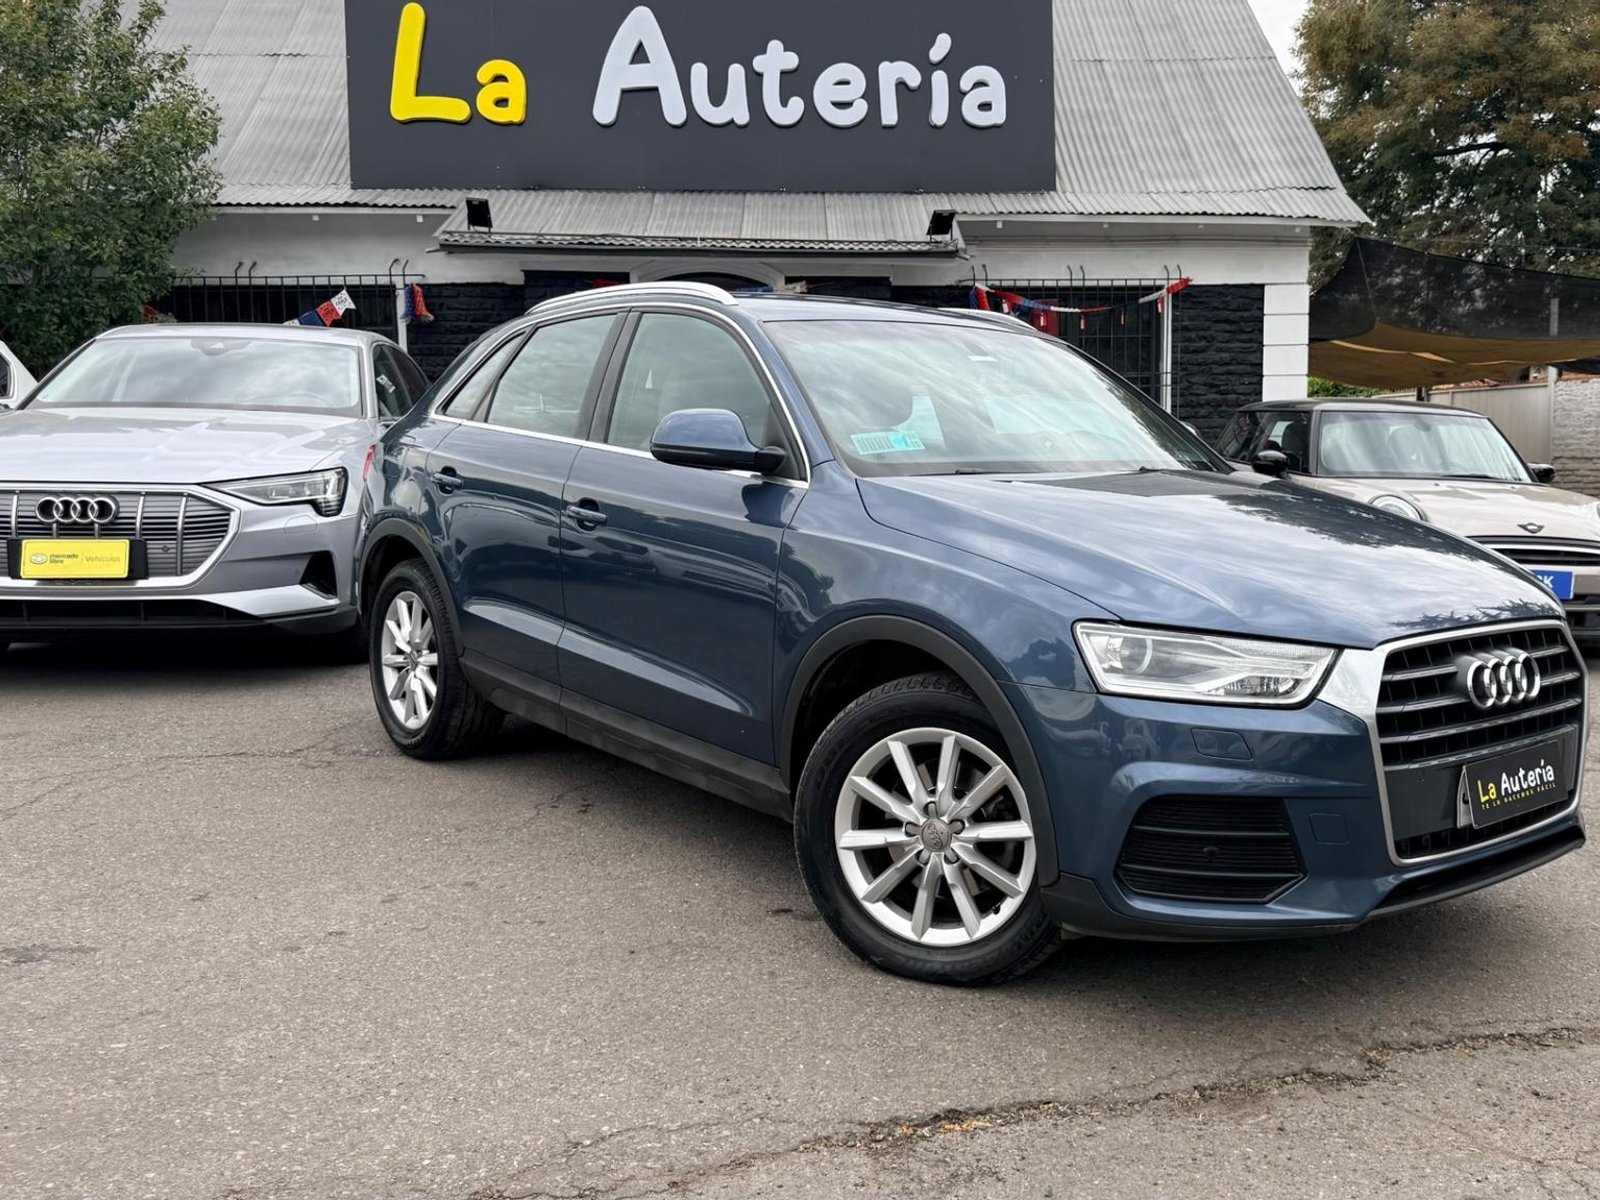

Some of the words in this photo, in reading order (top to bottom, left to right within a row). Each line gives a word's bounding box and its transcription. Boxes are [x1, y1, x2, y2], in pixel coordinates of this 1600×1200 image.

[390, 1, 528, 125] La
[592, 5, 1008, 128] Autería
[1477, 779, 1497, 803] La
[1501, 759, 1554, 796] Autería
